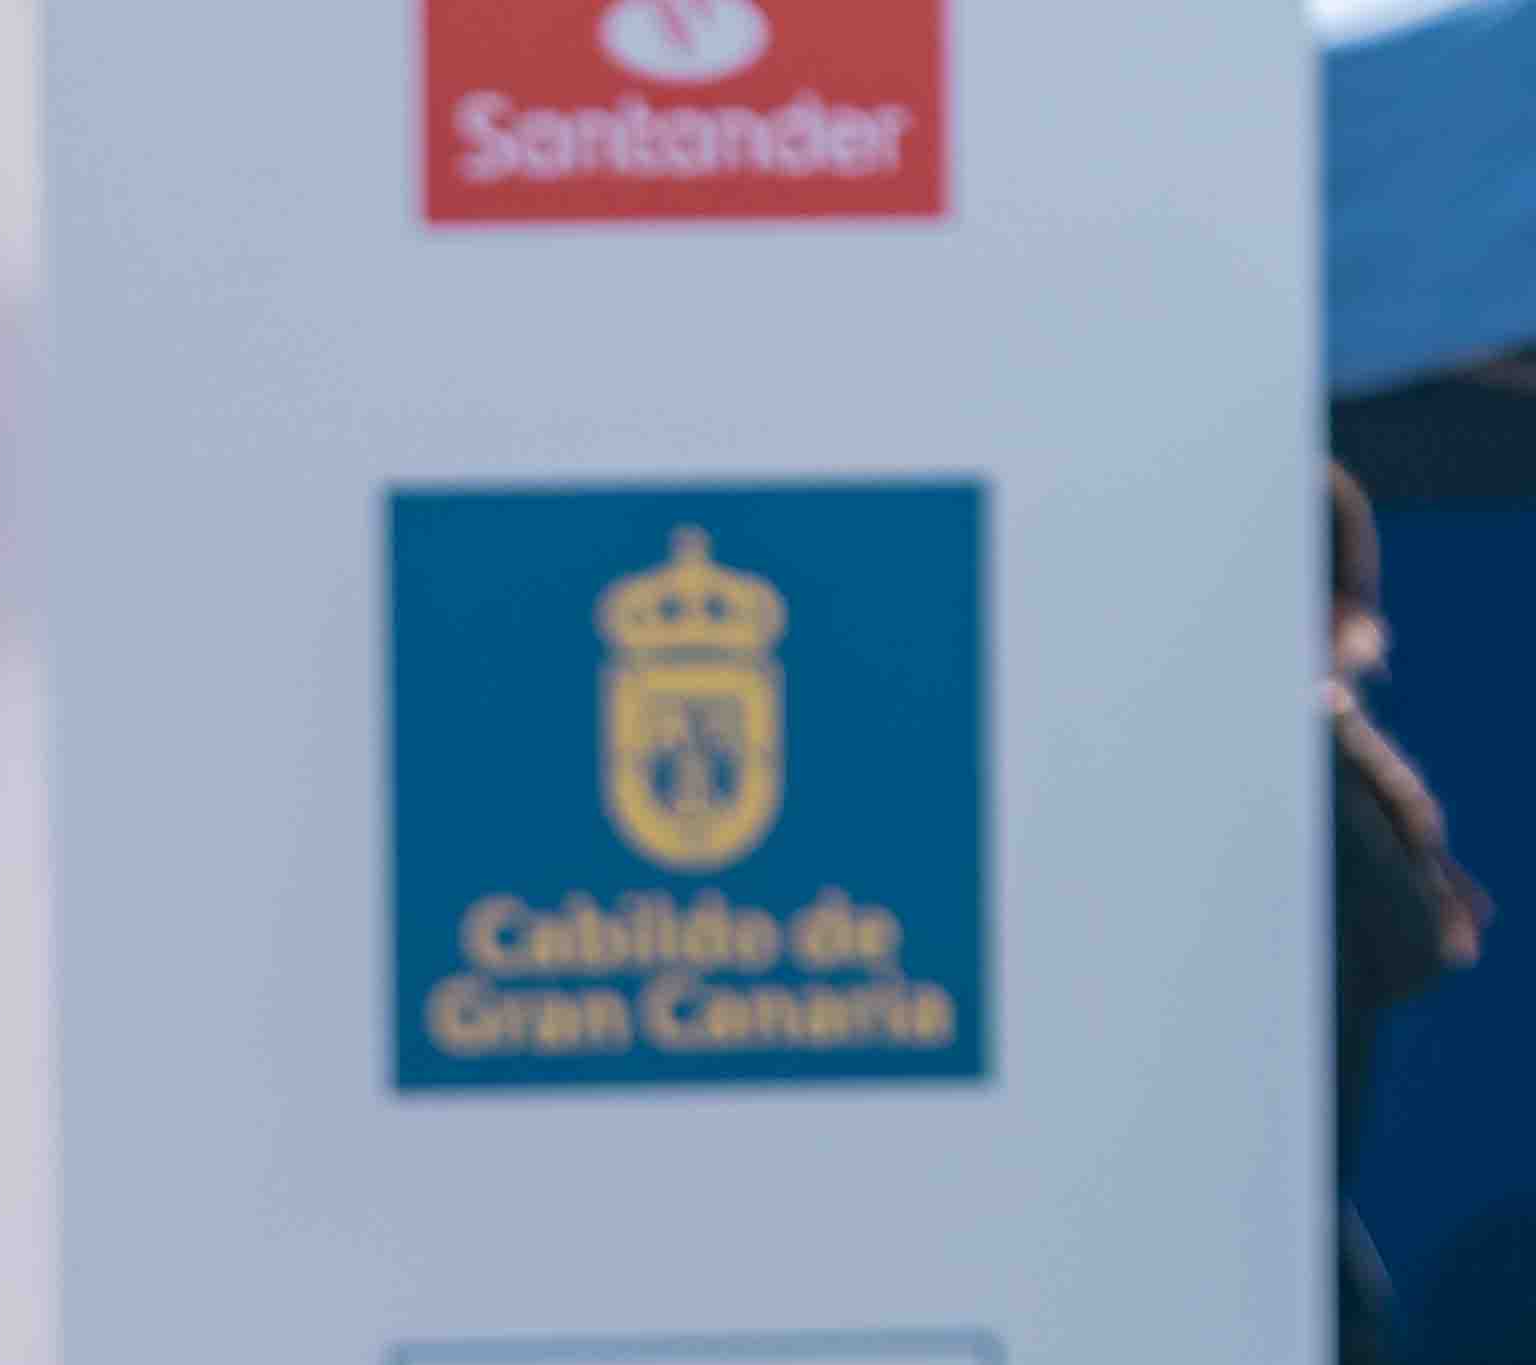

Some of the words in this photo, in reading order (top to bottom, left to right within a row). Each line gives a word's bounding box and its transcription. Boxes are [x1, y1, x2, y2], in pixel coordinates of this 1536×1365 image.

[450, 88, 914, 182] Santander
[460, 888, 786, 976] Cabildo
[794, 884, 904, 970] de
[426, 970, 632, 1060] Gran
[638, 966, 958, 1052] Canaria
